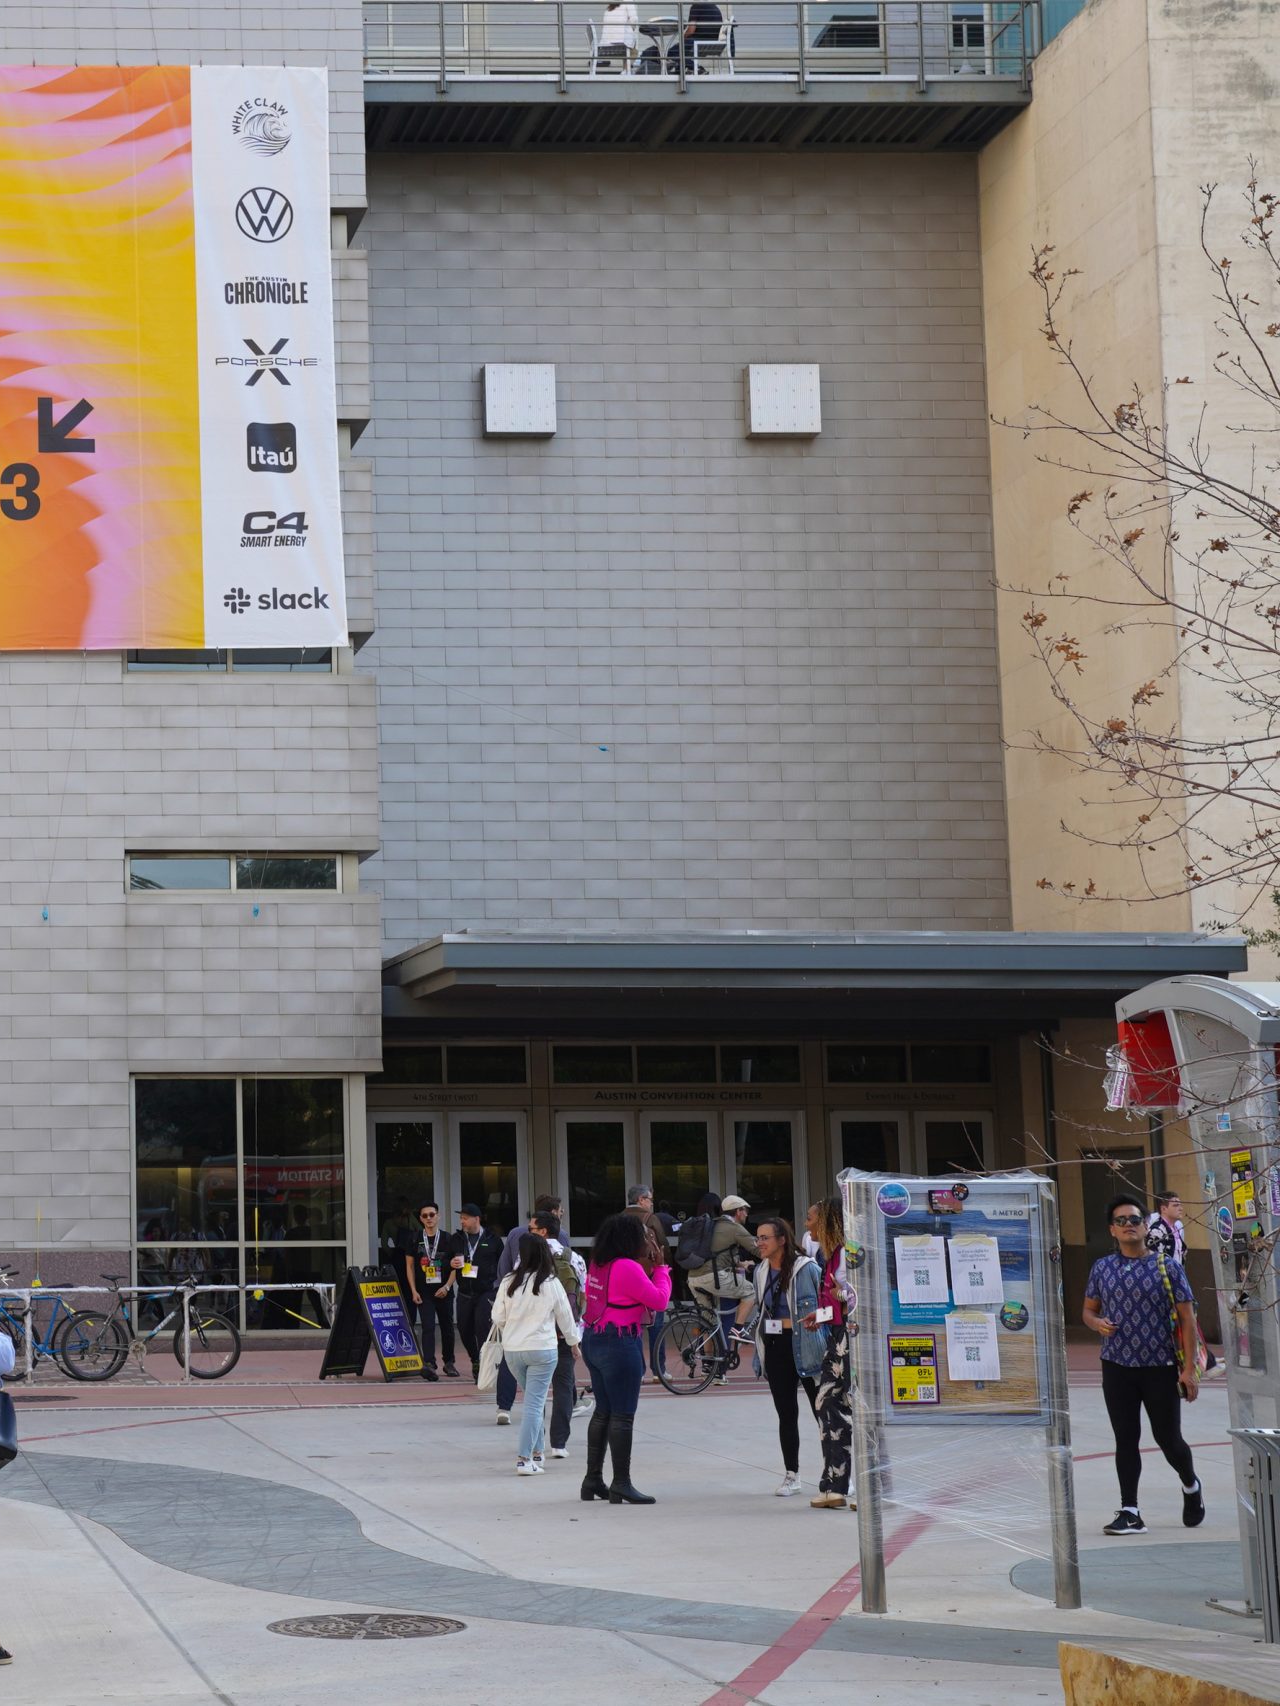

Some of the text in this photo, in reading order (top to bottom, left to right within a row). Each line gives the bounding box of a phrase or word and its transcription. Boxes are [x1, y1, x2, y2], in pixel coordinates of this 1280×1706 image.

[232, 98, 289, 135] WHITE CLAW
[224, 281, 309, 305] CHRONICLE
[215, 357, 318, 367] PORSCHE
[250, 446, 294, 466] Itaú
[242, 511, 309, 535] C4
[240, 535, 307, 548] SMART ENERGY
[257, 587, 330, 610] slack
[594, 1090, 763, 1101] AUSTIN CONVENTION CENTER
[998, 1209, 1024, 1217] METRO
[371, 1284, 395, 1294] CAUTION
[382, 1319, 399, 1327] TRAFFIC
[395, 1360, 419, 1370] CAUTION
